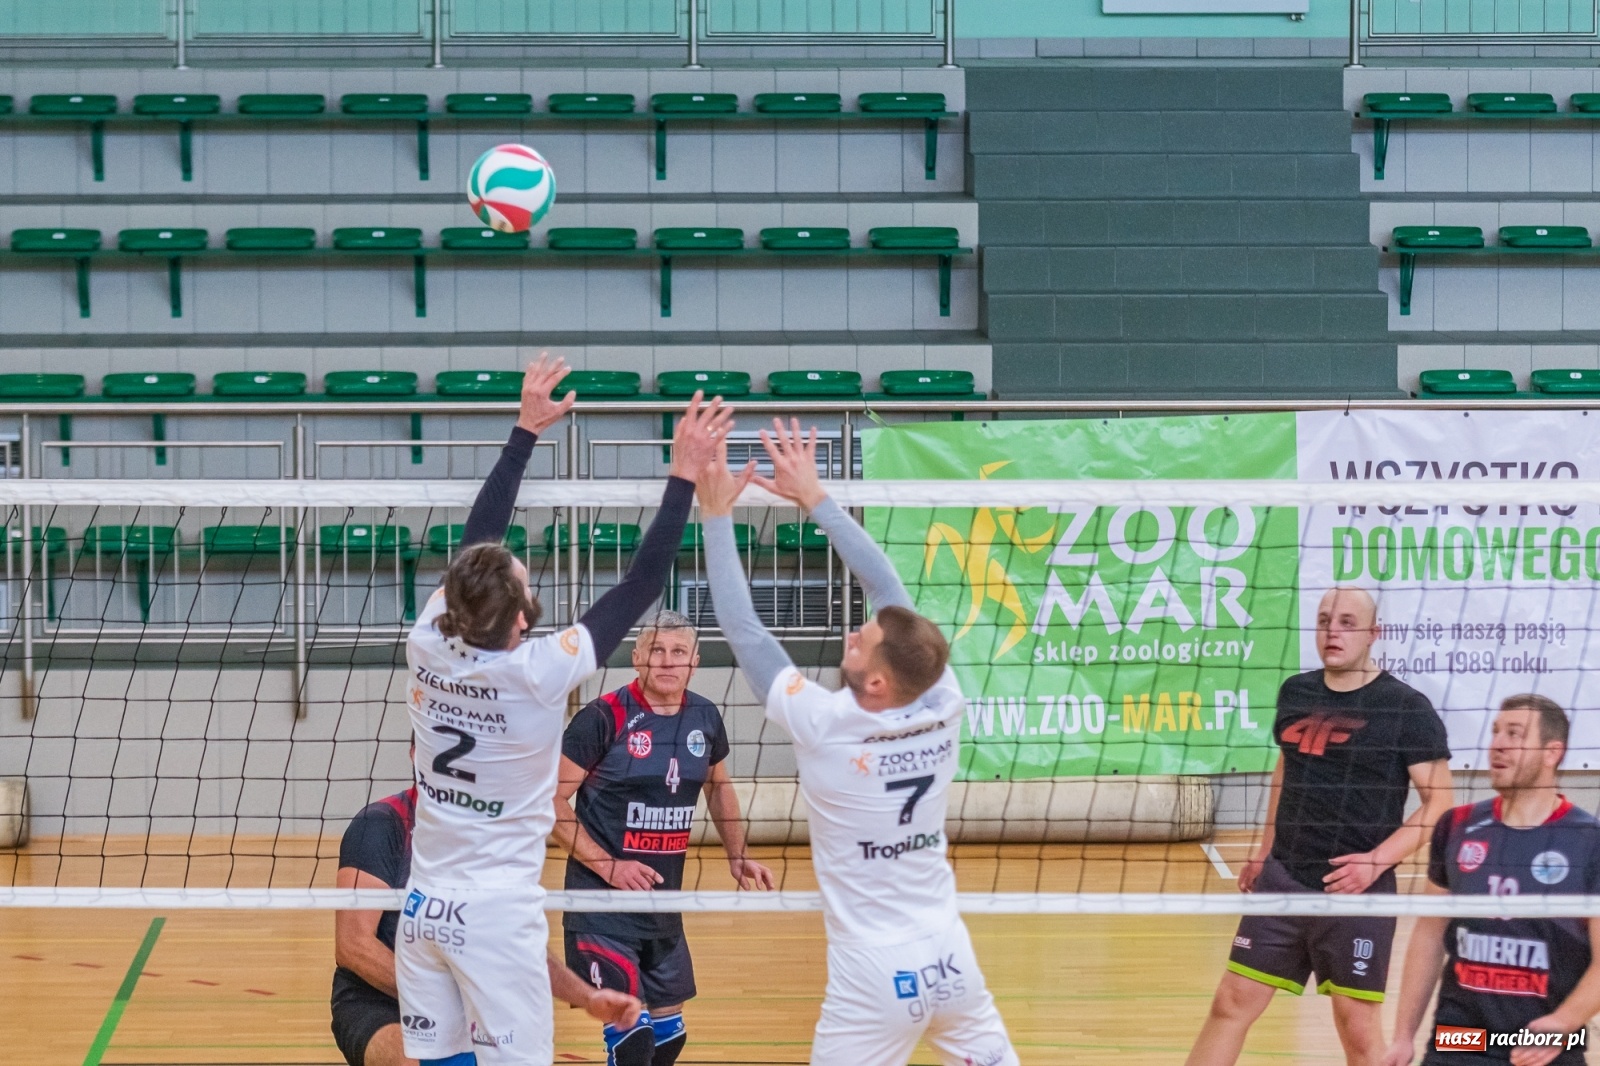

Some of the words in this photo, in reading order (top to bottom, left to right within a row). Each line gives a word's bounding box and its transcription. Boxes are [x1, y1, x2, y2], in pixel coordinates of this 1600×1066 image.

[1044, 503, 1256, 566] ZOO
[1031, 565, 1254, 637] MAR
[1415, 617, 1444, 647] się
[1451, 622, 1507, 646] naszą
[1514, 617, 1566, 646] pasją
[1034, 640, 1099, 666] sklep
[1109, 637, 1255, 664] zoologiczny
[1413, 651, 1436, 675] od
[1445, 651, 1495, 675] 1989
[1502, 650, 1554, 675] roku.
[416, 666, 498, 700] ZIELIŃSKI
[431, 725, 476, 784] 2
[665, 757, 681, 794] 4
[626, 801, 695, 830] OMERT
[885, 774, 935, 827] 7
[425, 897, 468, 926] DK
[403, 915, 466, 946] glass
[1353, 938, 1373, 960] 10
[590, 961, 602, 989] 4
[920, 953, 962, 989] DK
